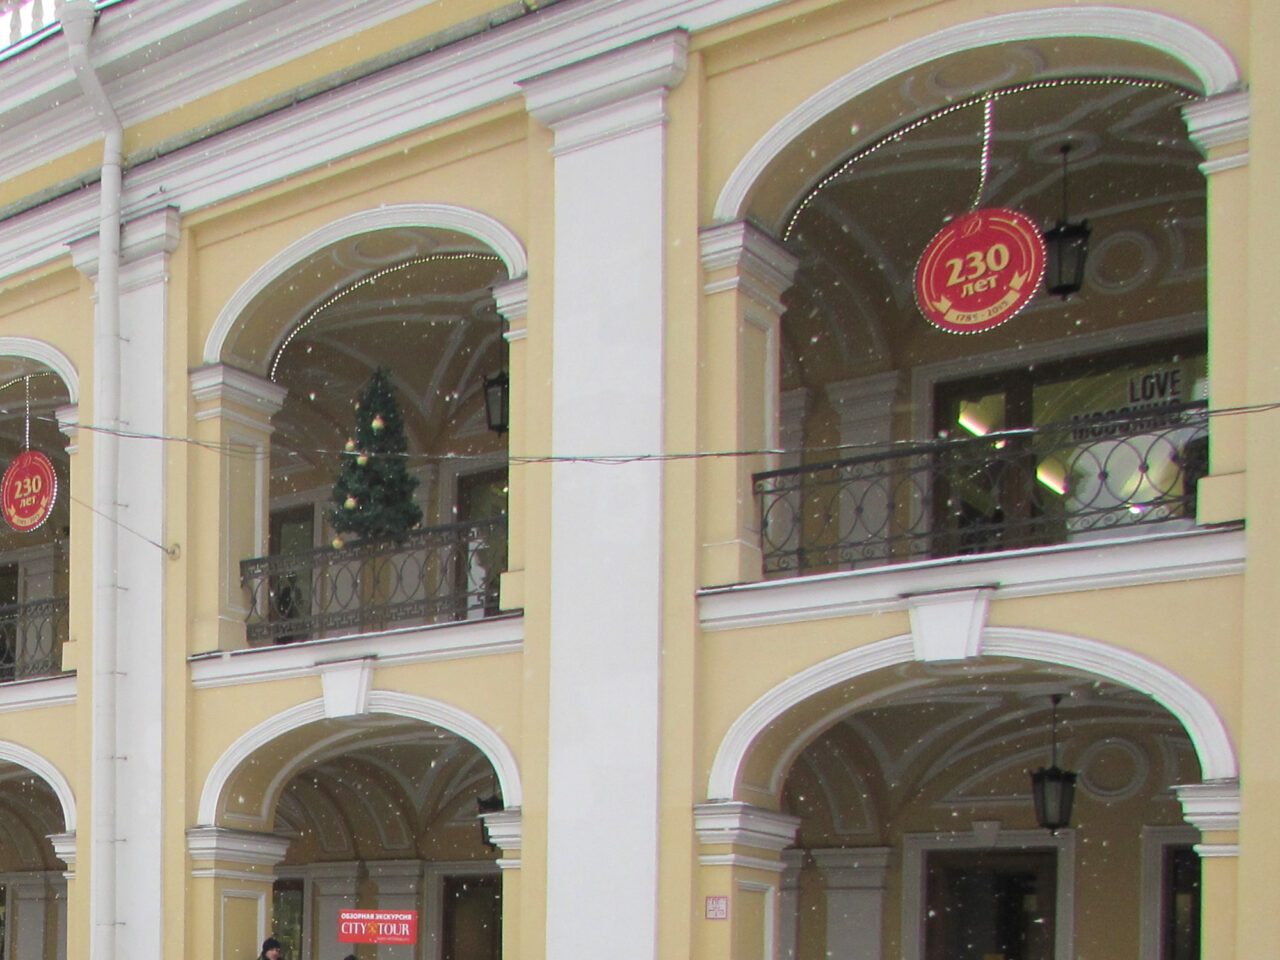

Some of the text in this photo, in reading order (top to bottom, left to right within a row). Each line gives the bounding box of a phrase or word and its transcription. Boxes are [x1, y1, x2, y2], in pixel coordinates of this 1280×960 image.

[945, 243, 1010, 288] 230
[960, 274, 998, 298] лет
[1128, 369, 1181, 403] LOVE
[14, 475, 42, 500] 230
[19, 496, 37, 509] лет
[341, 912, 413, 921] ОБЗОРНАЯ ЭКСКУРСИЯ
[341, 922, 410, 936] CITY TOUR
